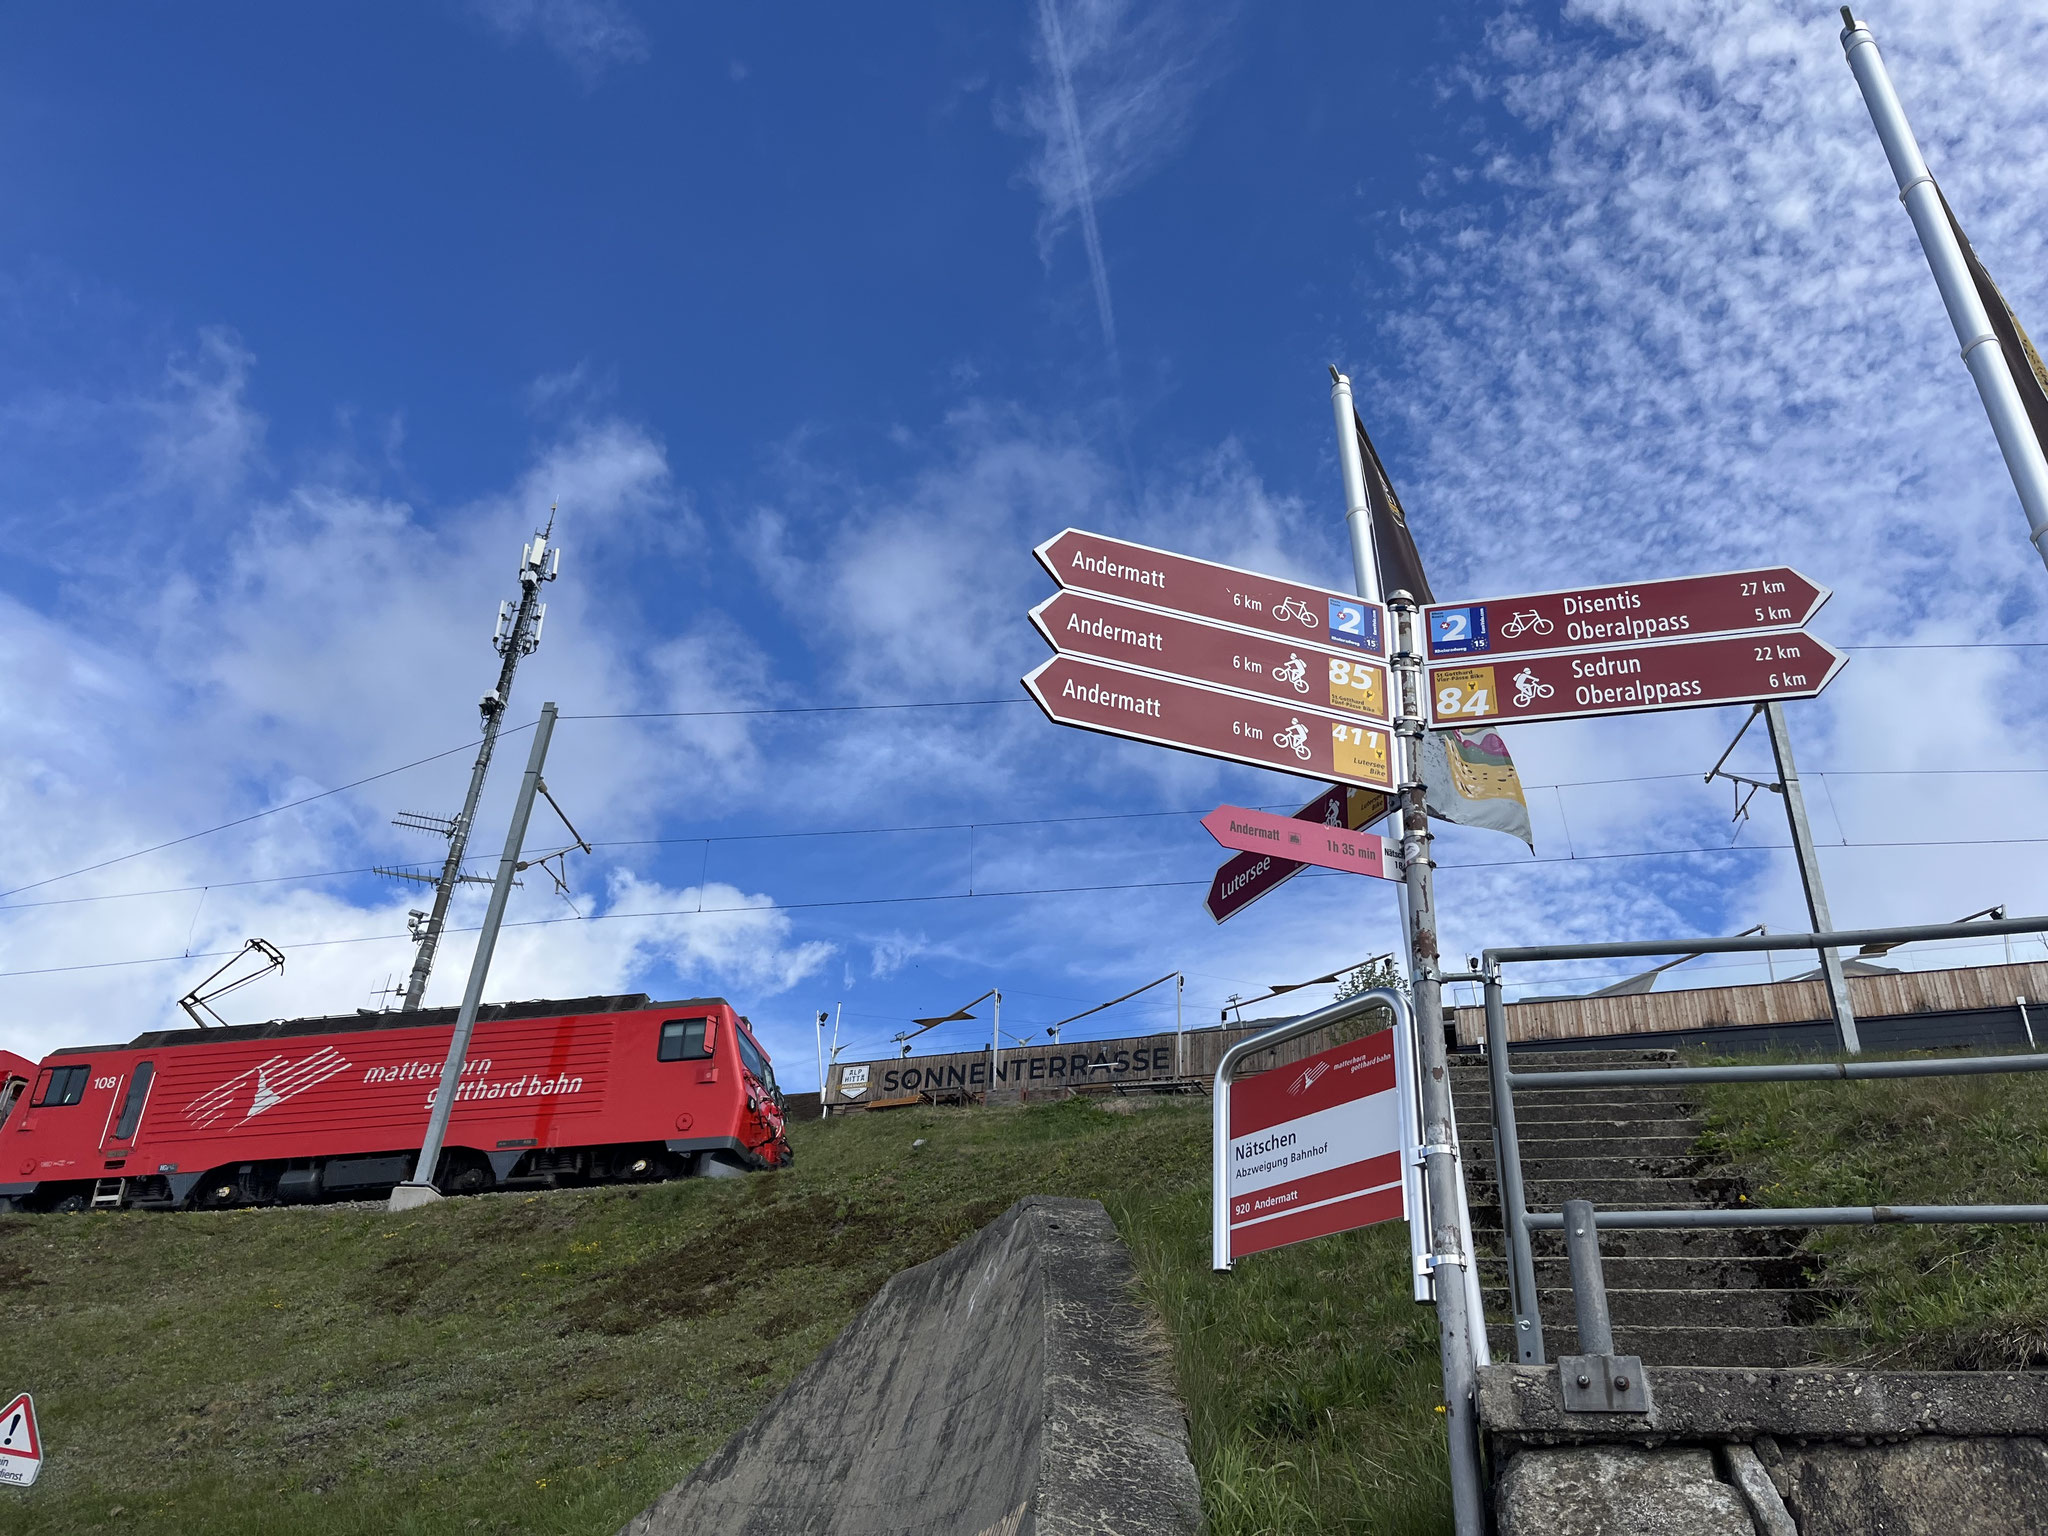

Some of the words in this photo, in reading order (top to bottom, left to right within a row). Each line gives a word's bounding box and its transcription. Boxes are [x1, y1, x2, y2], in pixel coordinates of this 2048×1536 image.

[1072, 550, 1165, 588] Andermatt
[1233, 593, 1241, 607] 6
[1244, 594, 1262, 611] km
[1563, 591, 1641, 616] Disentis
[1740, 582, 1759, 597] 27
[1762, 579, 1785, 595] km
[1338, 608, 1360, 634] 2
[1442, 614, 1466, 642] 2
[1567, 613, 1690, 640] Oberalppass
[1755, 607, 1763, 622] 5
[1765, 605, 1791, 621] km
[1067, 613, 1163, 651] Andermatt
[1233, 655, 1241, 669] 6
[1244, 656, 1262, 674] km
[1366, 639, 1376, 648] 15
[1474, 640, 1485, 648] 15
[1329, 659, 1374, 690] 85
[1572, 656, 1641, 679] Sedrun
[1754, 647, 1772, 662] 22
[1775, 644, 1801, 660] km
[1436, 688, 1490, 716] 84
[1575, 678, 1702, 706] Oberalppass
[1769, 674, 1778, 688] 6
[1780, 671, 1806, 687] km
[1062, 678, 1161, 718] Andermatt
[1233, 721, 1241, 736] 6
[1244, 722, 1263, 741] km
[1332, 724, 1378, 748] 411
[1353, 758, 1386, 770] Lutersee
[1370, 768, 1386, 776] Bike
[1230, 820, 1280, 841] Andermatt
[1327, 840, 1339, 853] 1h
[1342, 842, 1355, 856] 35
[1358, 846, 1376, 860] min
[1221, 856, 1271, 900] Lutersee
[363, 1058, 492, 1083] matterrn
[849, 1068, 862, 1076] ALP
[883, 1047, 1170, 1092] SONNENTERRASSE
[1334, 1054, 1366, 1070] matterhorn
[1351, 1056, 1376, 1074] gotthard
[1376, 1054, 1391, 1063] bahn
[94, 1076, 116, 1089] 108
[424, 1074, 527, 1110] gtthard
[526, 1072, 583, 1096] bahn
[1236, 1132, 1297, 1161] Nätschen
[1236, 1156, 1288, 1179] Abzweigung
[1291, 1142, 1328, 1162] Bahnhof
[1235, 1202, 1250, 1216] 920
[1254, 1190, 1298, 1210] Andermatt
